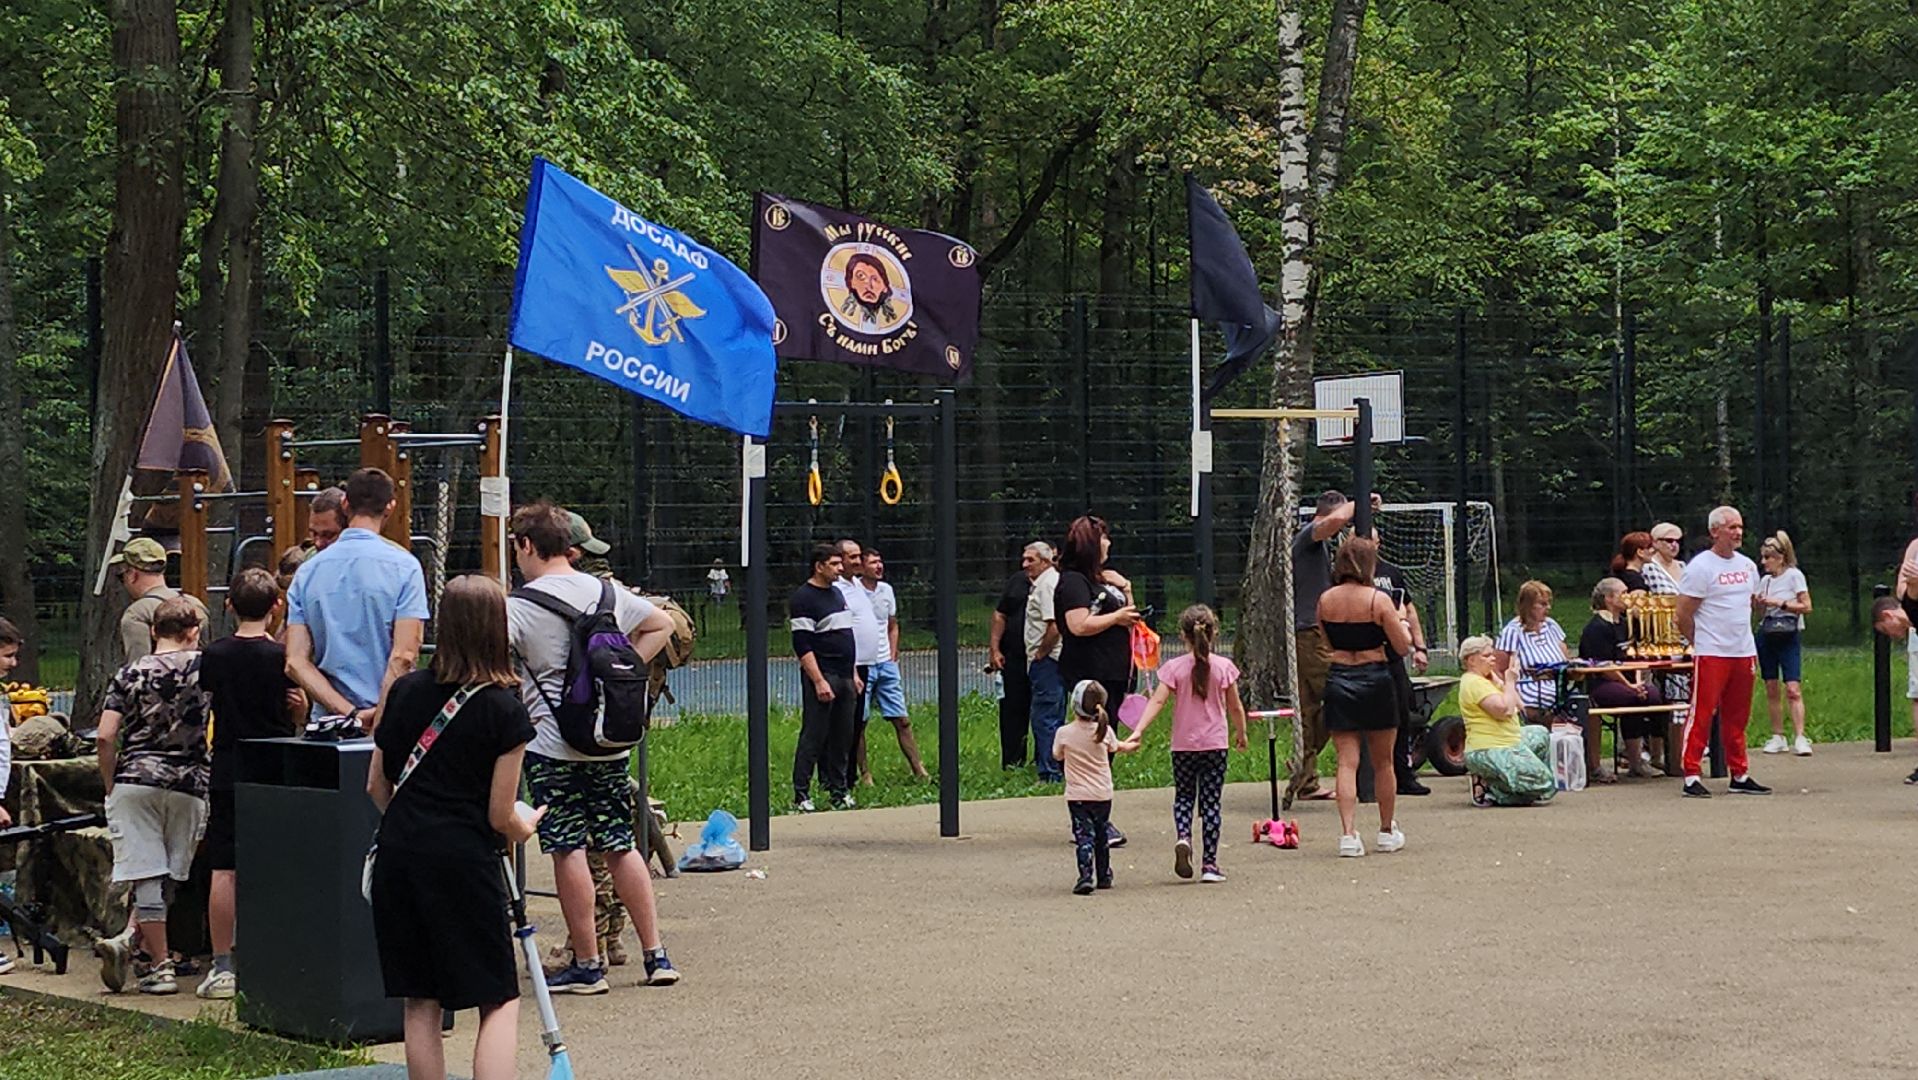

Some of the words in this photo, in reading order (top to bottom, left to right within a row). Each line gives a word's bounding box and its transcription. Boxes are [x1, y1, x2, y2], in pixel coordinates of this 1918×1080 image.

[611, 206, 708, 270] ДОСААФ
[824, 223, 852, 242] Мы
[585, 340, 691, 403] РОССИИ
